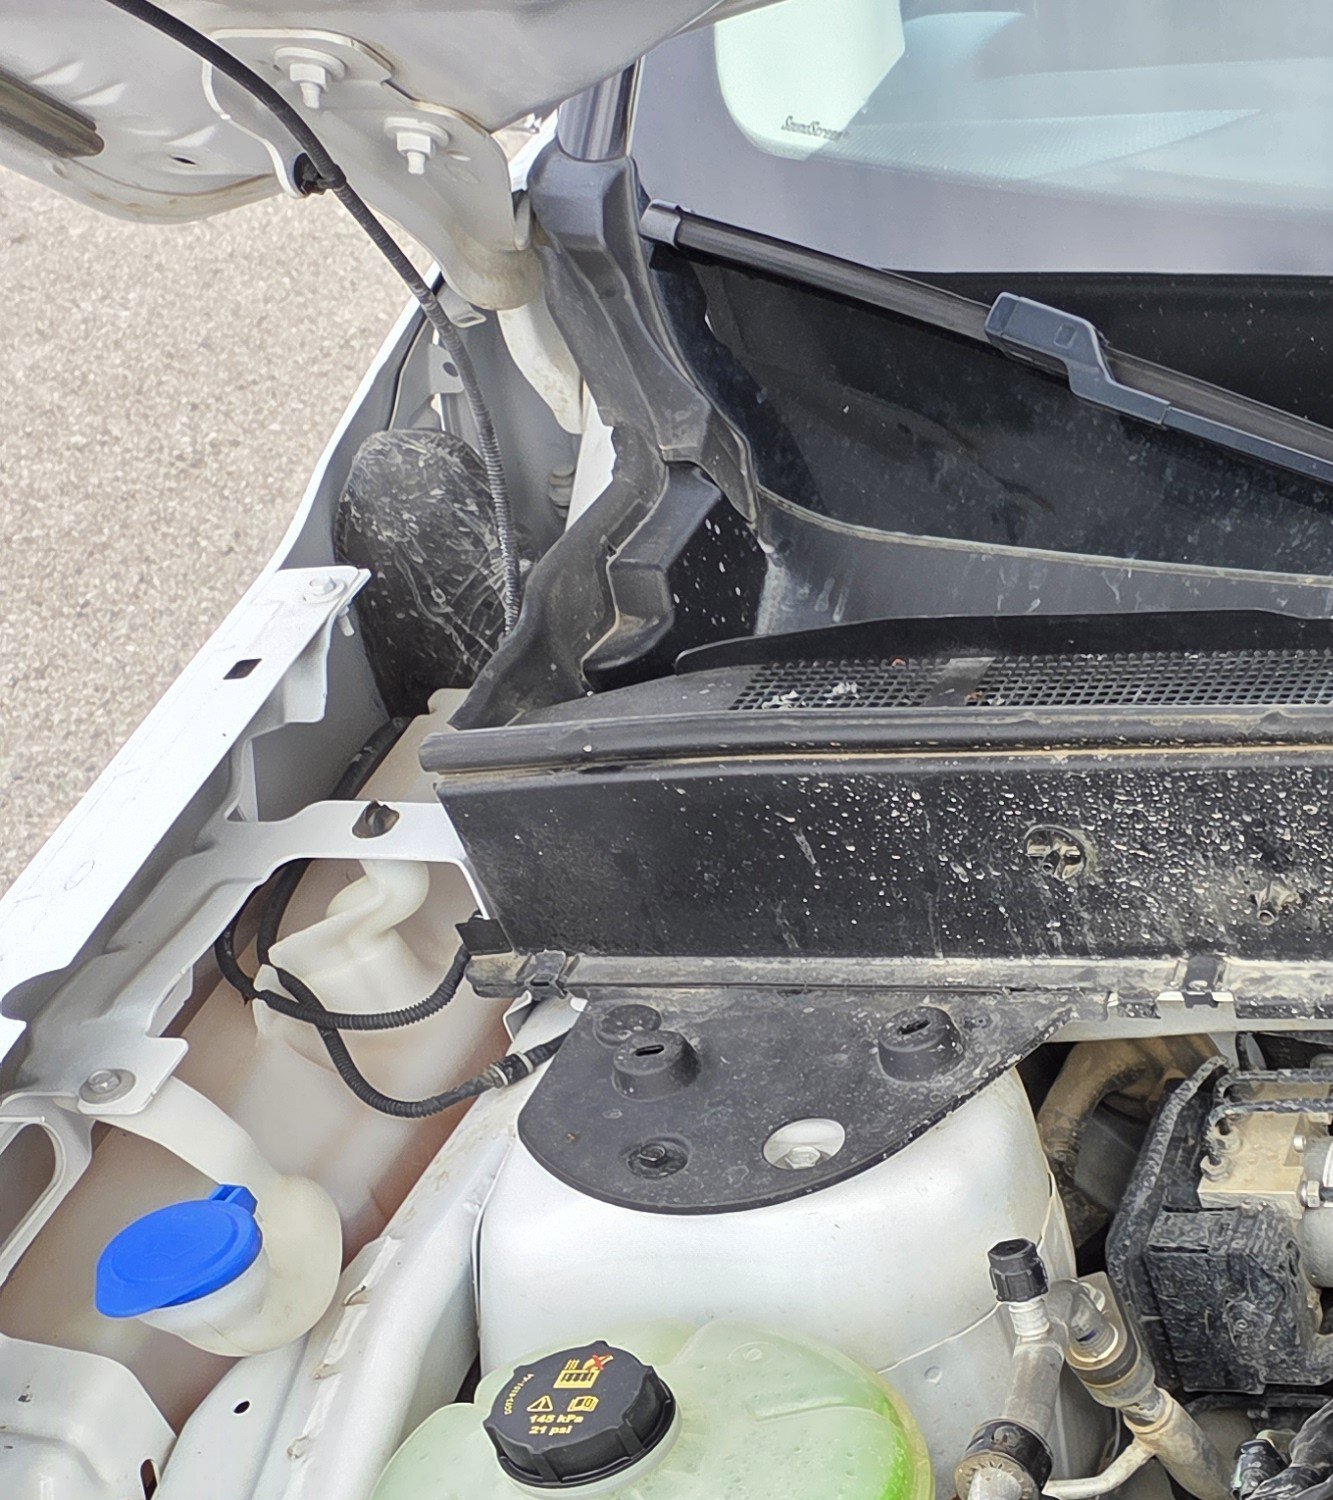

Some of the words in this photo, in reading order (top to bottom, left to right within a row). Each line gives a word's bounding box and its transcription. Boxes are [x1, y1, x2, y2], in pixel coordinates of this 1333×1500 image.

[528, 1414, 555, 1424] 145
[557, 1413, 584, 1424] kPa
[528, 1425, 547, 1435] 21
[549, 1425, 573, 1436] psi
